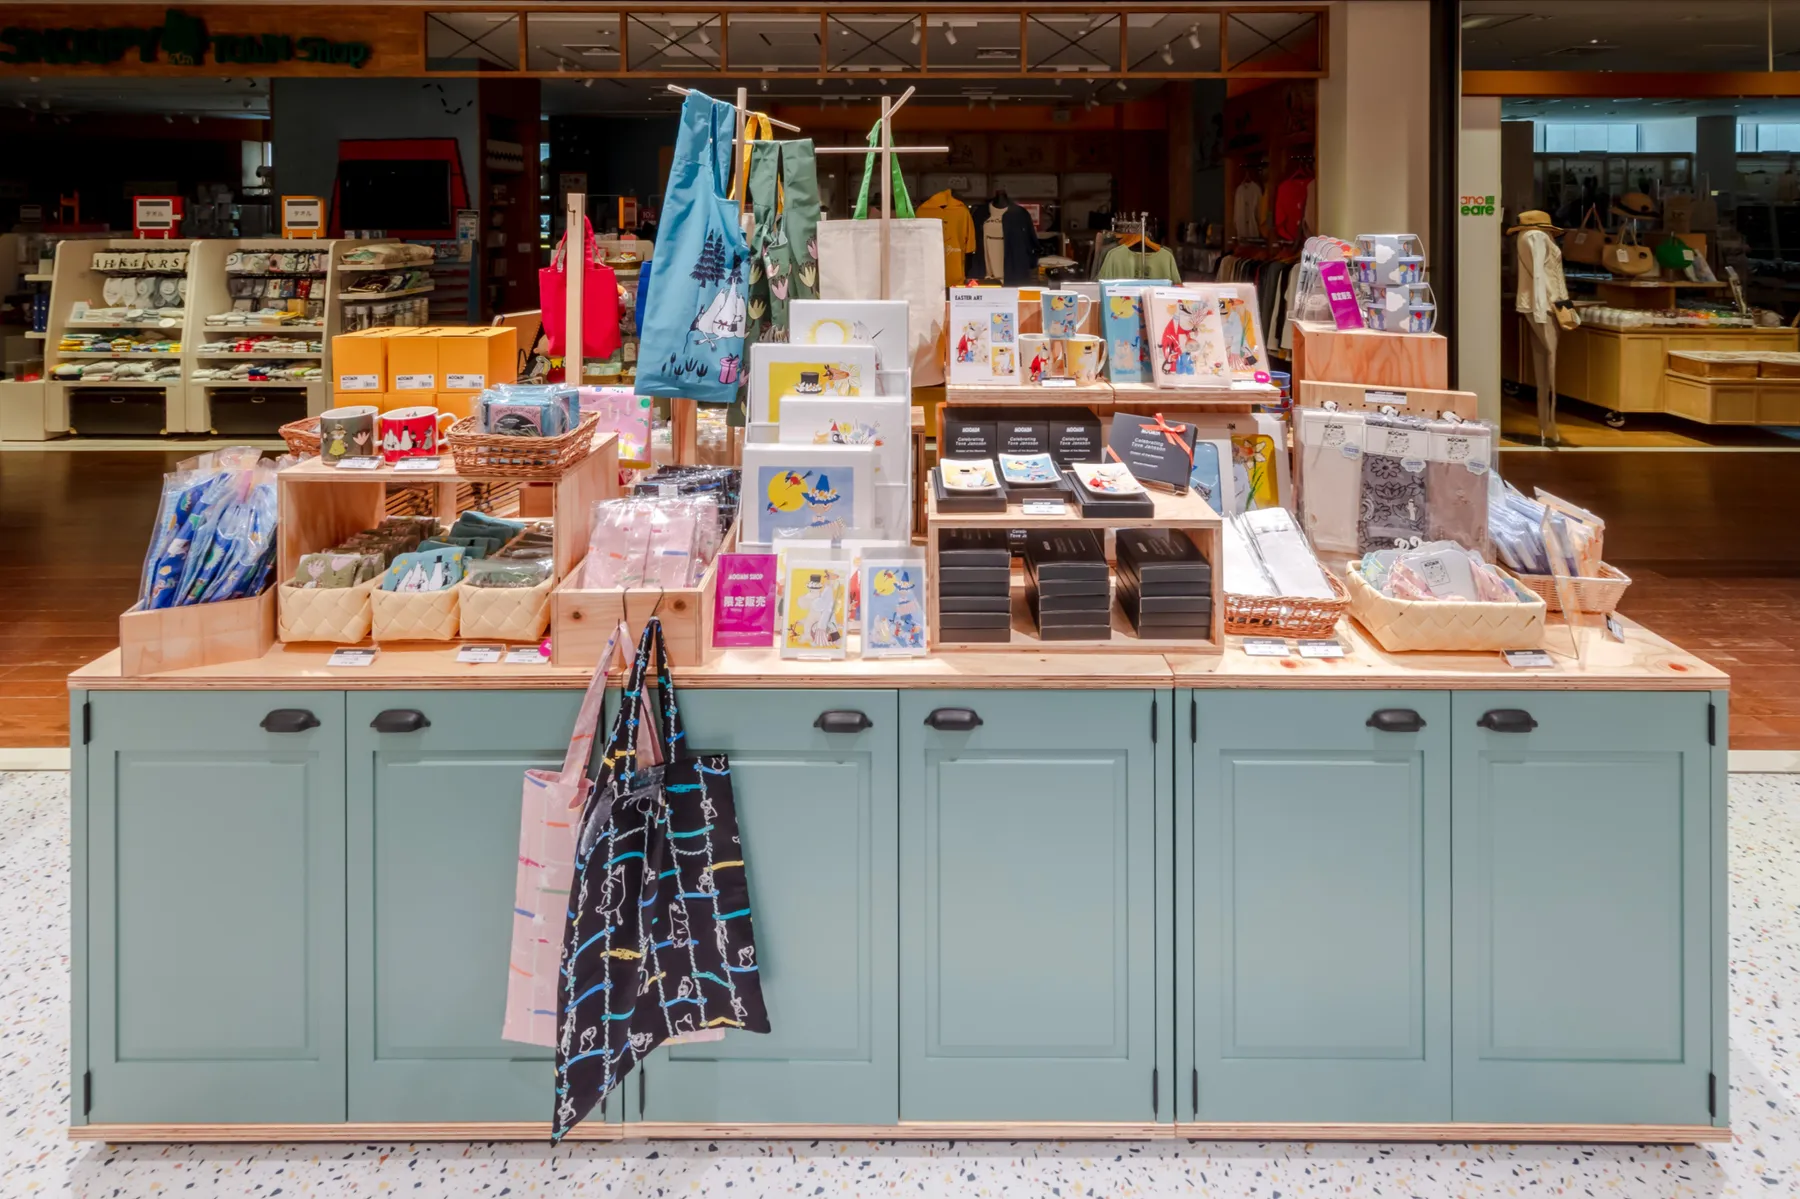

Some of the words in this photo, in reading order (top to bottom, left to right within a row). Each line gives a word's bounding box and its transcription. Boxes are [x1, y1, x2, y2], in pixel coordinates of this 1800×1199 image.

[1134, 438, 1164, 447] Celebrating
[723, 595, 766, 607] 限定販売
